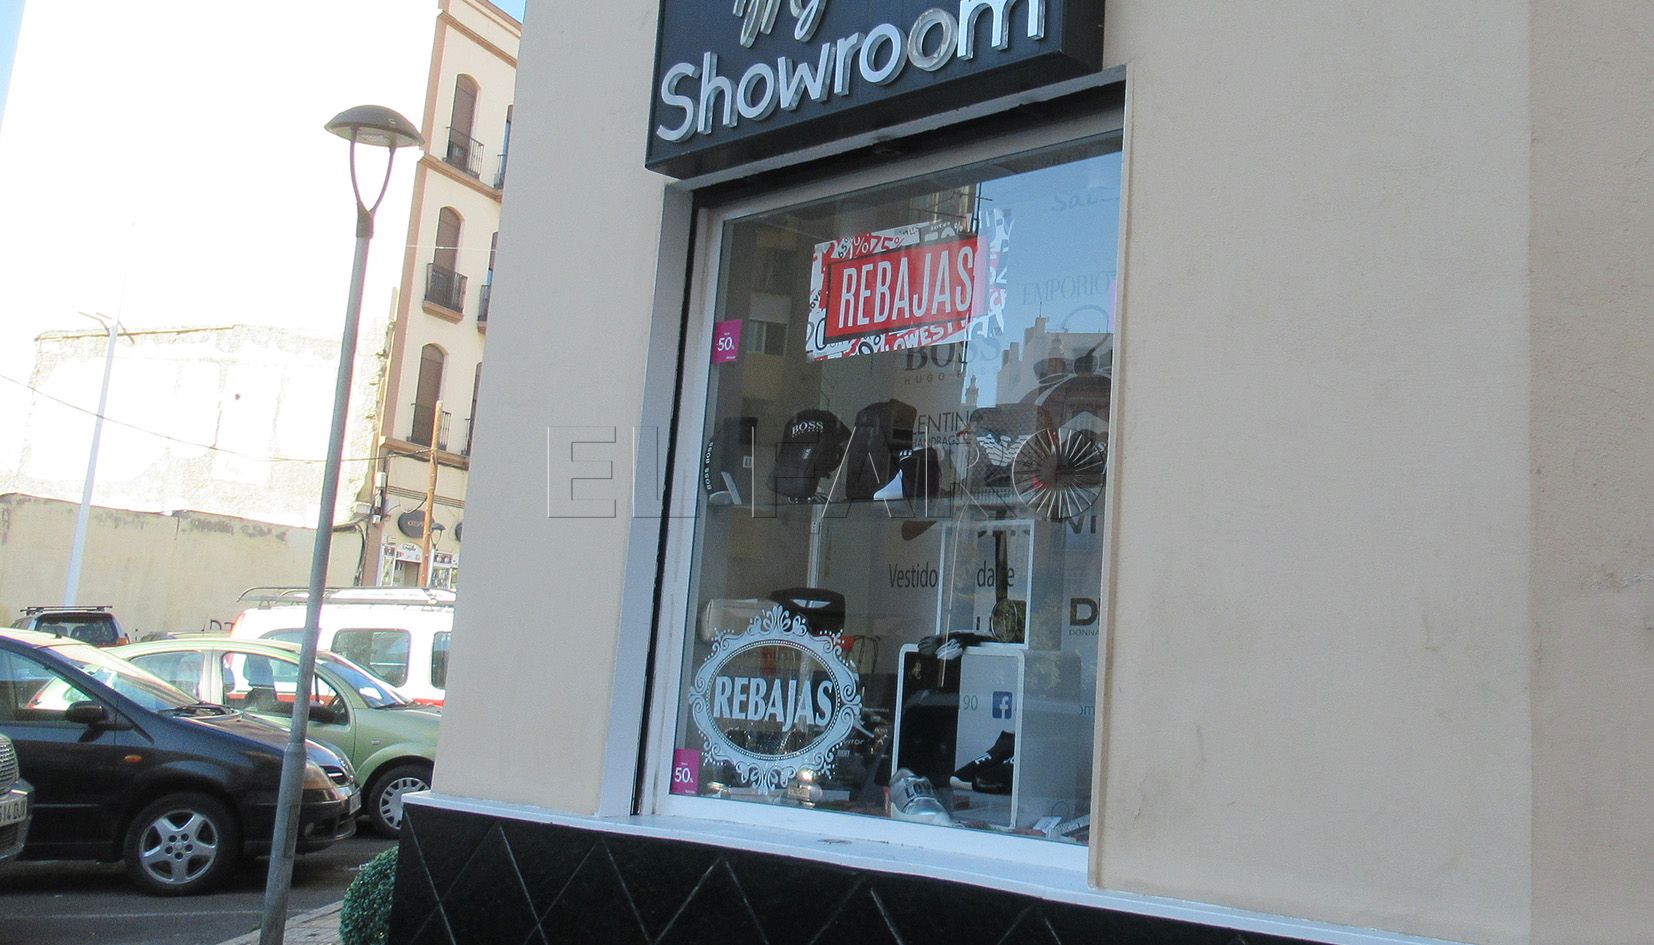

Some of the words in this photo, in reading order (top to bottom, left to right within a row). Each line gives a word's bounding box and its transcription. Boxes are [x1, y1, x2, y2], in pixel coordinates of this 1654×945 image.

[656, 0, 1046, 143] Showroom
[838, 246, 974, 329] REBAJAS
[792, 421, 824, 435] BOSS
[888, 563, 938, 588] Vestido
[714, 675, 833, 732] REBAJAS
